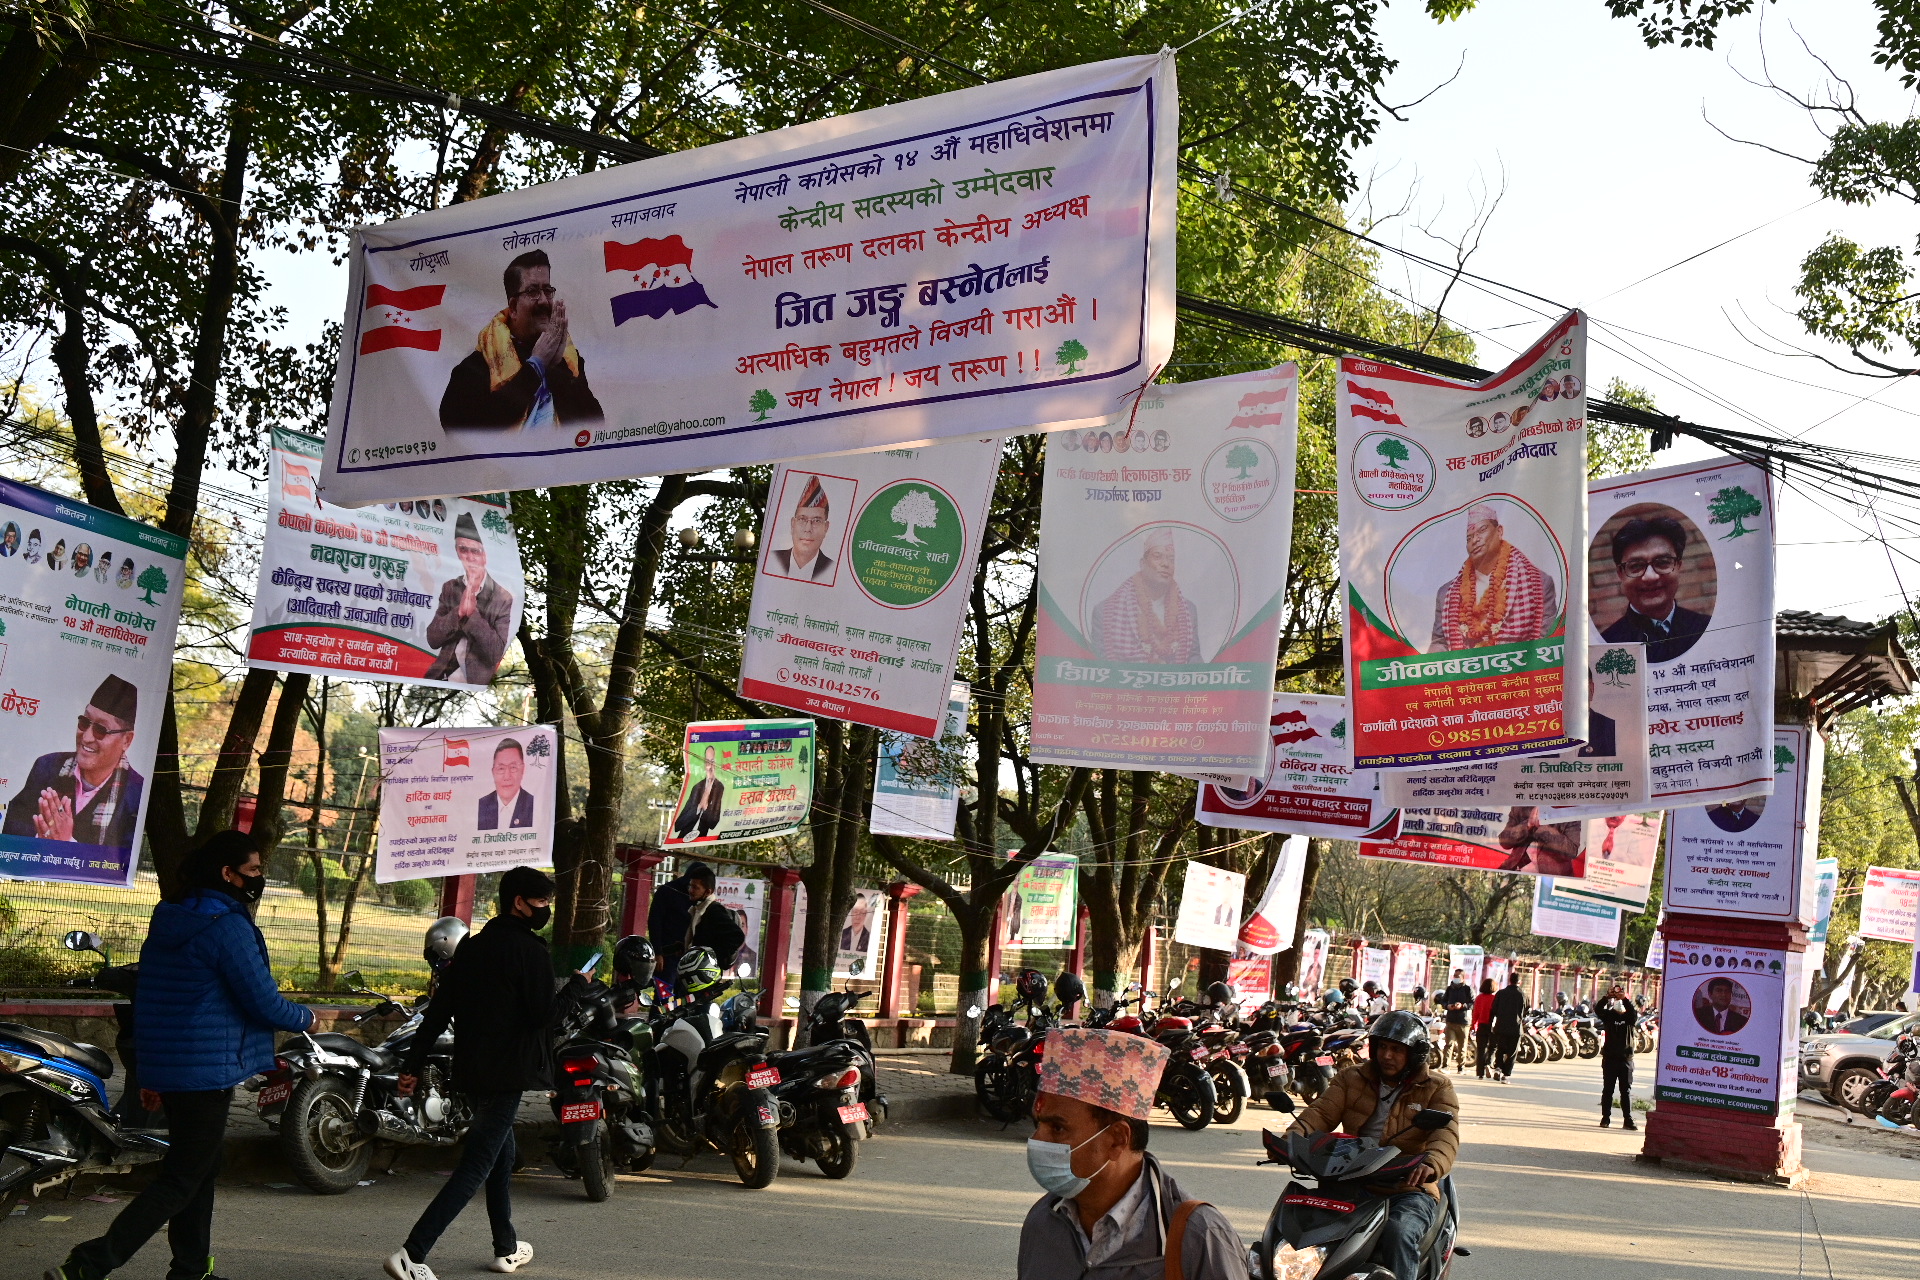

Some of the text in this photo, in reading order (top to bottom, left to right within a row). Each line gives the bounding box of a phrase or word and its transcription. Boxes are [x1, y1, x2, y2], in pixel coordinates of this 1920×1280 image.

[735, 112, 1114, 203] नेपाली कांग्रेसको १४ औं महाधिवेशनमा
[779, 166, 1056, 233] केन्द्रीय सदस्यको उम्मेदवार
[611, 203, 677, 228] समाजवाद
[503, 228, 557, 250] लोकतन्त्र
[742, 255, 794, 280] नेपाल
[861, 229, 925, 260] दलका
[936, 215, 1010, 249] केन्द्रीय
[1021, 194, 1090, 230] अध्यक्ष
[775, 292, 836, 329] जित
[736, 343, 832, 375] अत्याधिक
[839, 325, 922, 366] बहुमतले
[929, 308, 995, 346] विजयी
[785, 388, 822, 409] जय
[829, 378, 882, 402] नेपाल
[903, 365, 941, 388] जय
[592, 416, 725, 443] jitjungbasnet@yahoo.com
[1506, 441, 1558, 466] उम्मेदवार
[278, 509, 312, 532] नेपाली
[310, 543, 367, 573] नवराज
[858, 540, 950, 564] जीवनबहादुर शाही
[316, 577, 433, 609] सदस्य पदको उम्मेदवार
[65, 594, 111, 619] नेपाली
[114, 610, 156, 631] कांग्रेस
[343, 606, 389, 626] जनजाति
[64, 616, 148, 646] १४ महाधिवेशन
[346, 639, 374, 652] समर्थन
[377, 642, 398, 656] सहित
[777, 633, 847, 657] जीवनबहादुर
[320, 652, 341, 664] मतले
[343, 654, 366, 667] विजय
[822, 657, 845, 675] विजयी
[1376, 650, 1528, 682] जीवनबहादुर
[1652, 669, 1666, 680] १४
[1690, 654, 1755, 673] महाधिवेशनमा
[792, 672, 880, 701] 9851042576
[1424, 685, 1452, 697] नेपाली
[1534, 672, 1560, 683] सदस्य
[1653, 678, 1716, 696] राज्यमन्त्री एवं
[805, 697, 845, 713] जय नेपाल
[1676, 698, 1702, 710] नेपाल
[1735, 690, 1750, 701] दल
[1441, 714, 1464, 726] सान
[1467, 706, 1530, 723] जीवनबहादुर
[1685, 711, 1744, 731] राणालाई
[1448, 718, 1560, 744] 9851042576
[1676, 739, 1714, 754] सदस्य
[1521, 765, 1536, 773] मा.
[1596, 762, 1623, 773] लामा
[1698, 754, 1732, 771] विजयी
[1312, 775, 1349, 786] उम्मेदवार
[1654, 778, 1692, 790] जय नेपाल
[1294, 797, 1310, 806] रण
[1312, 798, 1341, 810] बहादुर
[1344, 801, 1368, 812] रावल
[1461, 808, 1503, 822] उम्मेदवार
[407, 815, 448, 827] शुभकामना
[1712, 1065, 1729, 1078] १४
